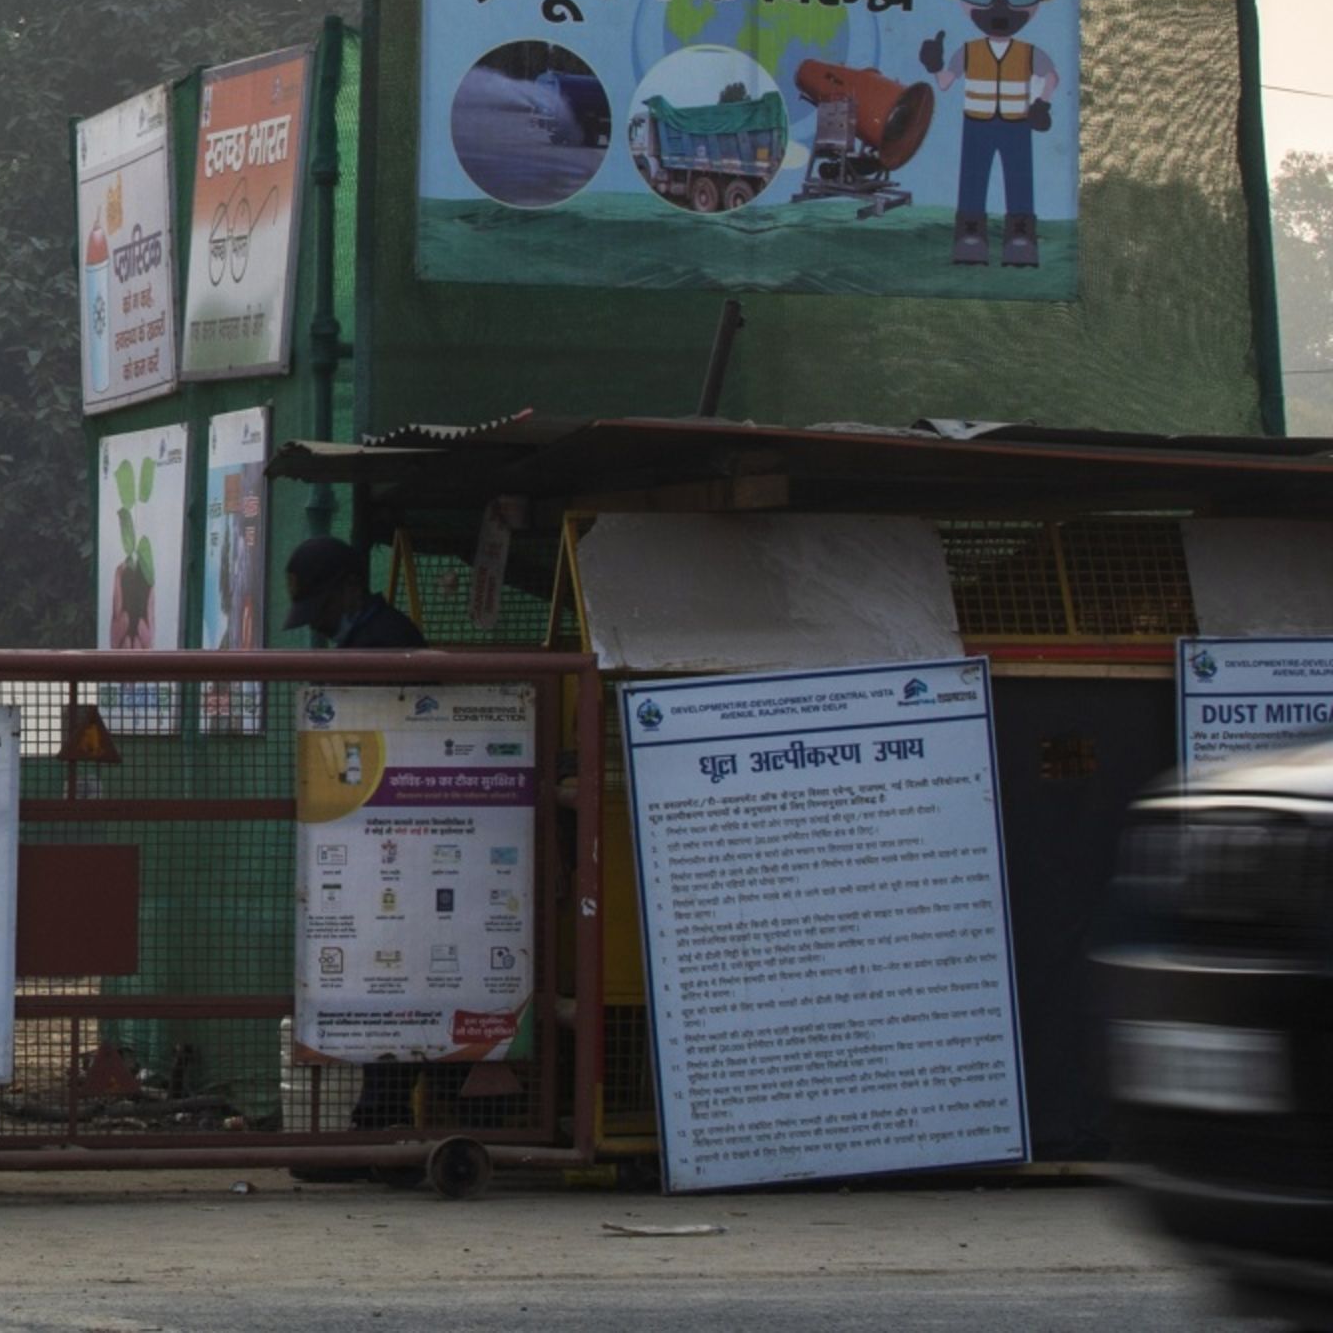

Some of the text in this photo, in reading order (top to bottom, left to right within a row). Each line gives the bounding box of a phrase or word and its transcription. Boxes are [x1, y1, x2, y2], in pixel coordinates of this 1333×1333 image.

[205, 124, 249, 178] स्वच्छ
[248, 114, 292, 166] भारत
[452, 706, 514, 714] ENGINEERING
[452, 714, 526, 722] CONSTRUCTION
[1202, 704, 1258, 724] DUST
[700, 736, 924, 783] धूल अल्पीकरण उपाय
